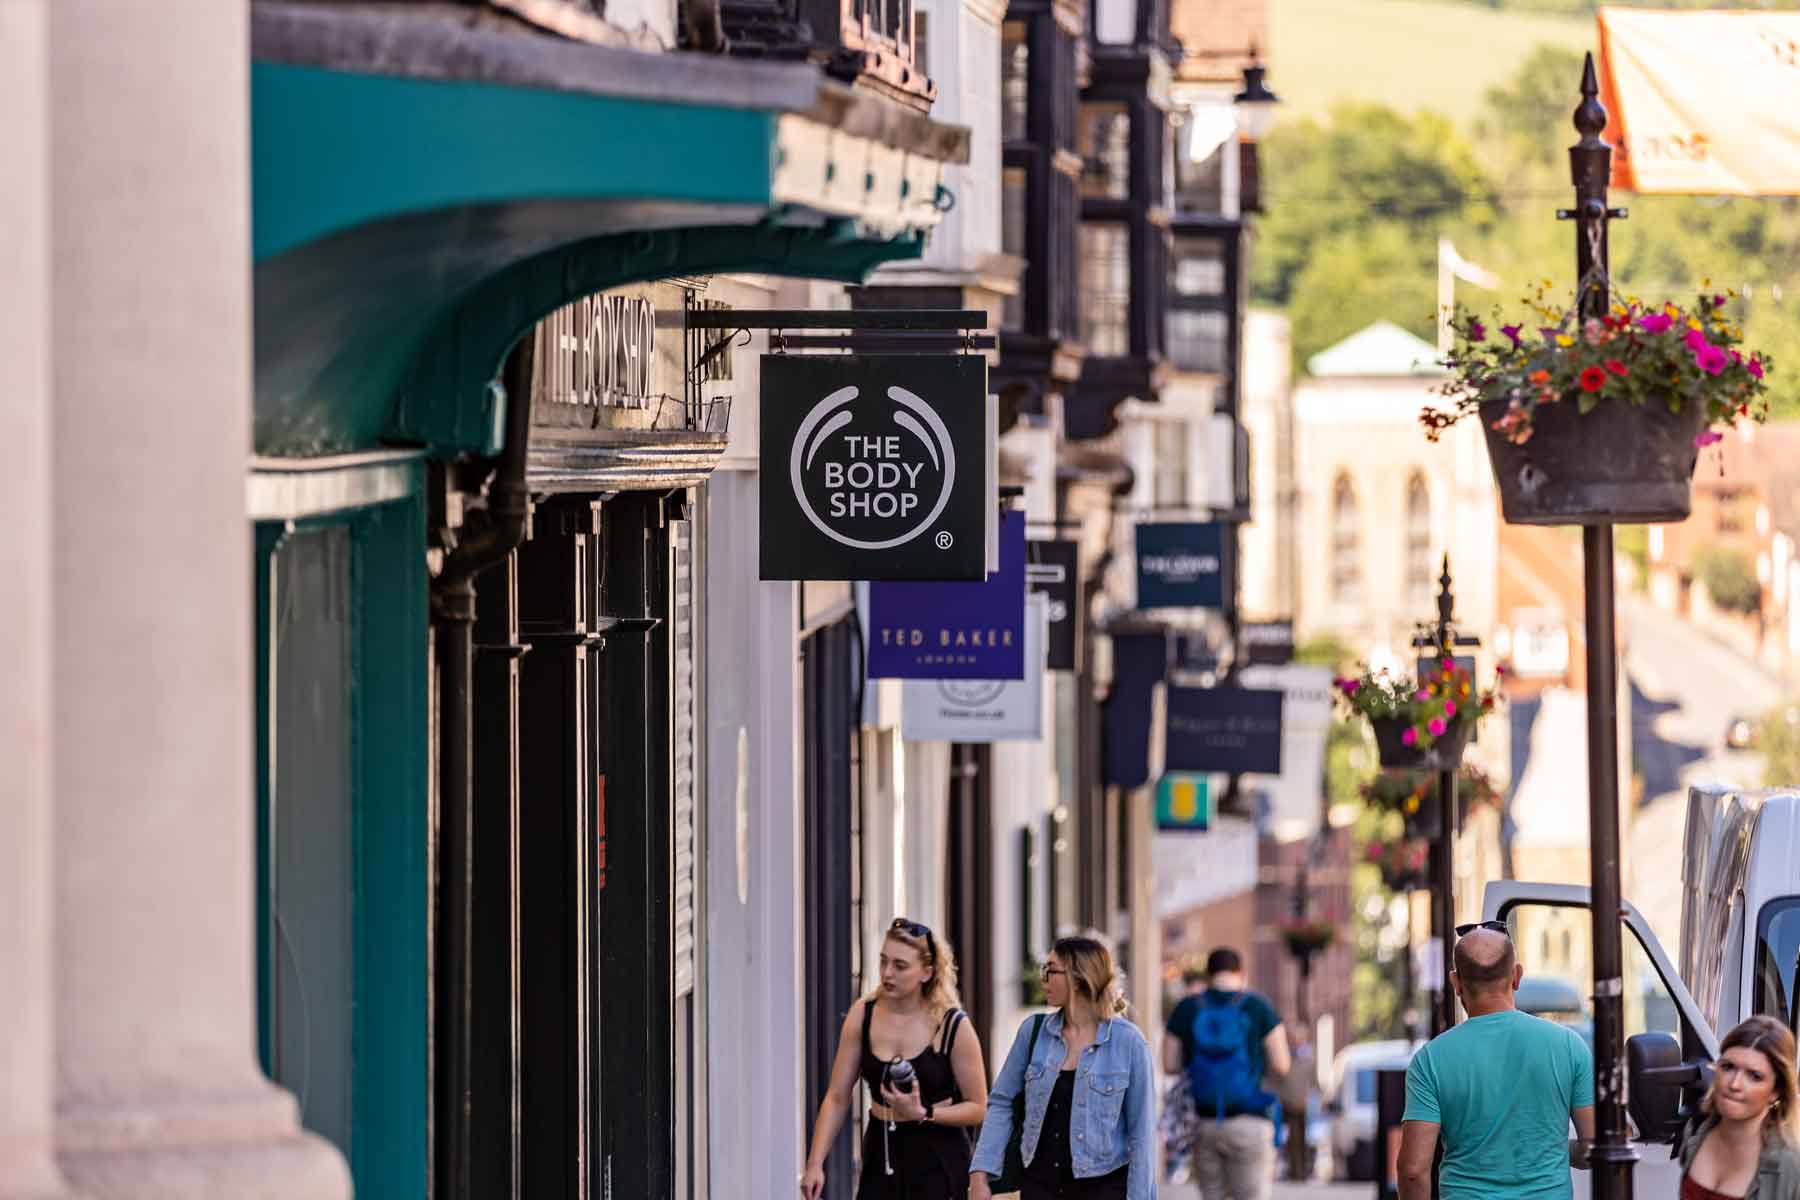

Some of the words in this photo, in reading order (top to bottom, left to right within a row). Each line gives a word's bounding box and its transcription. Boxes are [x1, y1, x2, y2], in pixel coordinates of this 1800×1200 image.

[583, 293, 621, 407] BODY
[623, 296, 656, 409] SHOP
[844, 436, 900, 458] THE
[825, 462, 925, 489] BODY
[830, 492, 918, 518] SHOP
[882, 629, 923, 647] TED
[940, 629, 1013, 647] BAKER
